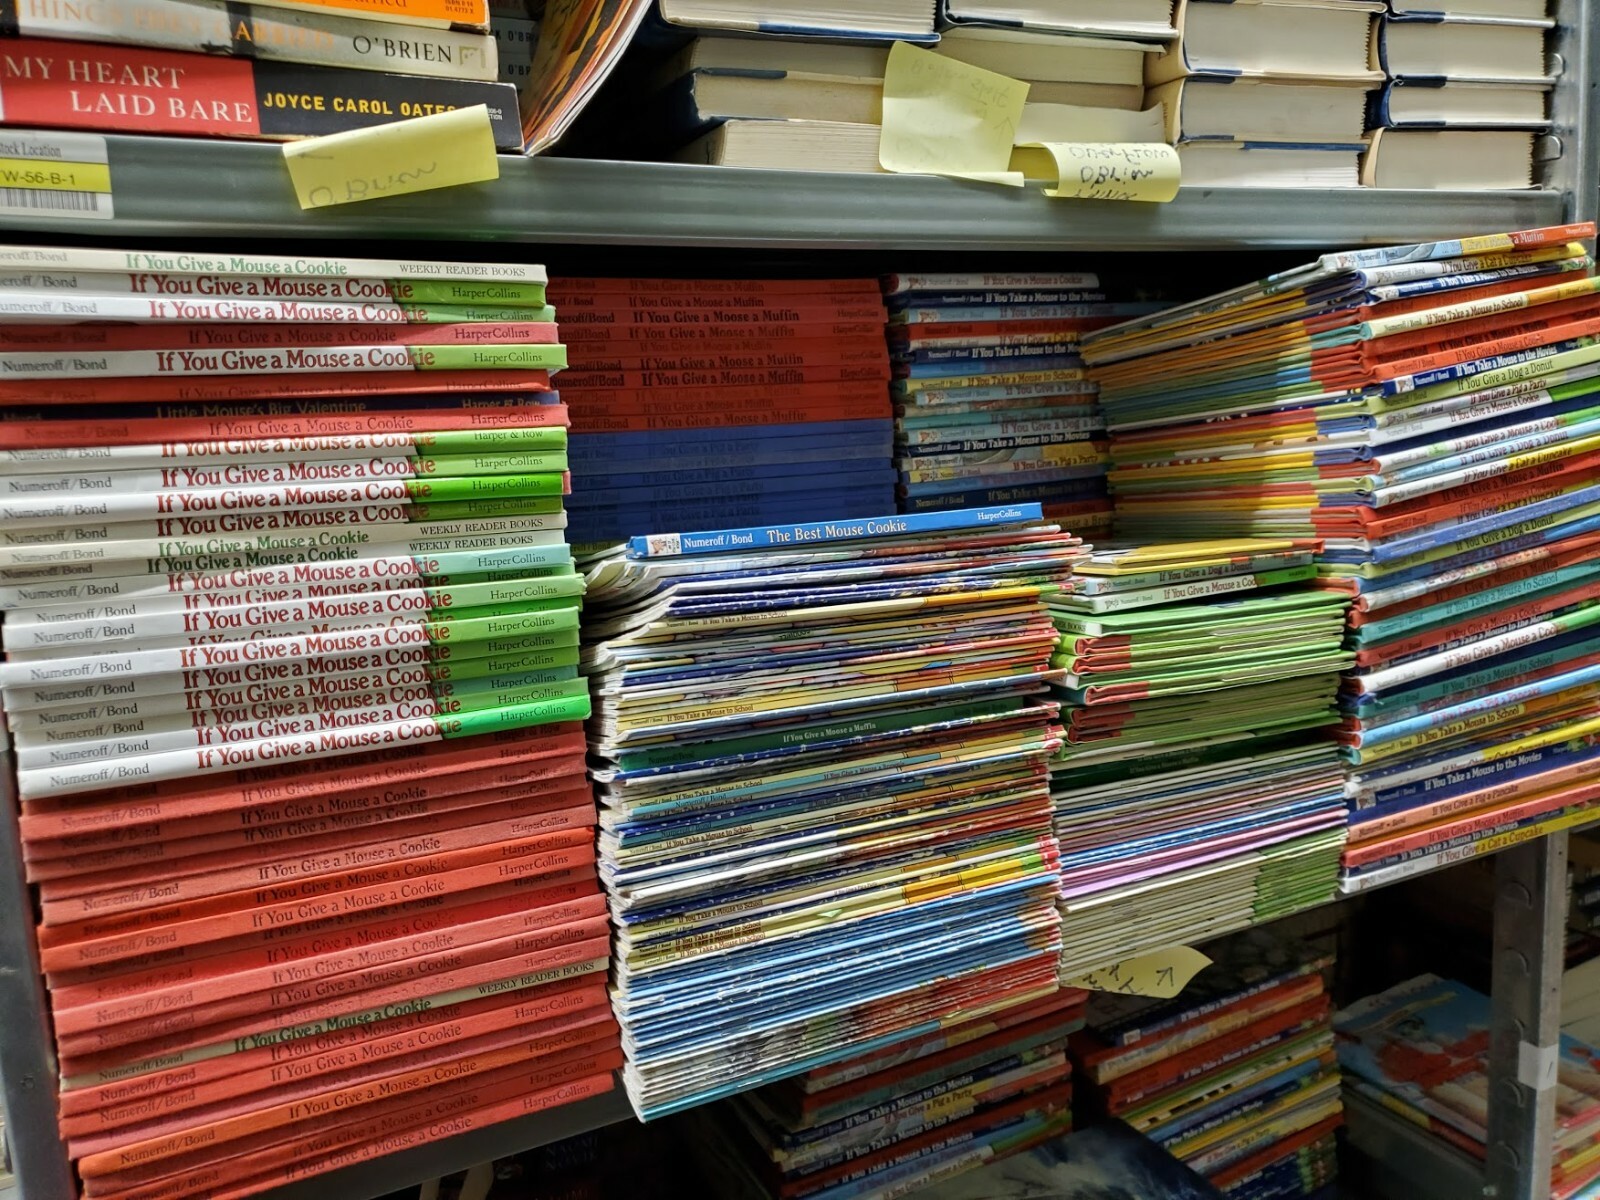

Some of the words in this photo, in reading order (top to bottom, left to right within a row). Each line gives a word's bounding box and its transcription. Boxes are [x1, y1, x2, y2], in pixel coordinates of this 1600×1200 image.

[353, 34, 452, 63] O'BRIEN
[5, 55, 53, 80] MY
[67, 59, 185, 89] HEART
[70, 90, 156, 117] LAID
[168, 97, 252, 124] BARE
[264, 92, 325, 111] JOYCE
[333, 97, 394, 116] CAROL
[0, 141, 20, 156] tock
[22, 142, 62, 158] Location
[126, 254, 140, 268] If
[144, 254, 175, 270] You
[177, 256, 216, 272] Give
[217, 261, 227, 272] a
[230, 258, 282, 274] Mouse
[284, 262, 292, 274] a
[295, 259, 348, 276] Cookie
[400, 264, 442, 275] WEEKLY
[445, 265, 488, 276] READER
[491, 266, 526, 277] BOOKS
[130, 273, 148, 292] If
[150, 274, 192, 295] You
[196, 275, 244, 296] Give
[247, 281, 260, 296] a
[262, 277, 328, 298] Mouse
[330, 284, 342, 298] a
[345, 278, 414, 298] Cookie
[452, 286, 521, 300] HarperCollins
[634, 310, 644, 323] If
[649, 310, 671, 323] You
[675, 310, 700, 322] Give
[704, 313, 710, 322] a
[713, 310, 750, 322] Moose
[753, 312, 760, 322] a
[763, 308, 800, 322] Muffin
[156, 352, 176, 372] If
[176, 352, 218, 372] You
[222, 350, 268, 370] Give
[270, 355, 282, 369] a
[286, 349, 350, 369] Mouse
[353, 352, 364, 367] a
[368, 348, 436, 368] Cookie
[474, 351, 542, 365] HarperCollins
[1457, 379, 1464, 392] If
[1466, 378, 1481, 390] You
[1482, 374, 1500, 386] Give
[1501, 374, 1506, 382] a
[1509, 368, 1524, 381] Dog
[1524, 368, 1530, 376] a
[1531, 361, 1554, 374] Donut
[156, 494, 175, 514] If
[177, 492, 218, 512] You
[220, 490, 266, 510] Give
[268, 491, 281, 506] a
[284, 485, 348, 506] Mouse
[350, 488, 362, 500] a
[365, 480, 432, 500] Cookie
[472, 478, 541, 492] HarperCollins
[767, 529, 791, 543] The
[794, 526, 821, 542] Best
[825, 524, 864, 538] Mouse
[867, 520, 907, 536] Cookie
[977, 508, 1022, 522] HarperCollins
[182, 612, 202, 632] If
[204, 610, 242, 630] You
[244, 606, 290, 626] Give
[292, 608, 304, 622] a
[307, 600, 370, 620] Mouse
[373, 601, 384, 614] a
[386, 591, 452, 612] Cookie
[490, 585, 558, 600] HarperCollins
[196, 750, 214, 769] If
[214, 747, 254, 768] You
[257, 741, 302, 762] Give
[304, 740, 316, 754] a
[320, 733, 380, 752] Mouse
[383, 731, 394, 744] a
[396, 720, 462, 741] Cookie
[500, 704, 567, 721] HarperCollins
[783, 735, 790, 743] If
[804, 732, 820, 740] Give
[826, 728, 848, 736] Moose
[854, 722, 876, 732] Muffin
[1424, 778, 1432, 791] If
[1432, 778, 1446, 789] You
[1447, 773, 1466, 786] Take
[1466, 772, 1471, 780] a
[1472, 766, 1496, 779] Mouse
[1496, 763, 1504, 772] to
[1505, 758, 1518, 770] the
[1518, 752, 1542, 767] Movies
[1436, 852, 1445, 865] If
[1446, 850, 1460, 862] You
[1462, 844, 1480, 857] Give
[1487, 838, 1500, 850] Cat
[1509, 824, 1544, 843] Cupcake
[252, 907, 265, 928] If
[266, 906, 294, 924] You
[298, 901, 328, 920] Give
[331, 902, 339, 912] a
[344, 890, 388, 910] Mouse
[390, 890, 398, 900] a
[400, 879, 446, 898] Cookie
[498, 854, 569, 877] HarperCollins
[290, 1106, 301, 1119] If
[302, 1101, 330, 1116] You
[334, 1092, 362, 1108] Give
[366, 1090, 375, 1100] a
[378, 1077, 420, 1097] Mouse
[424, 1074, 431, 1084] a
[434, 1060, 478, 1081] Cookie
[529, 1028, 597, 1053] HarperCollins
